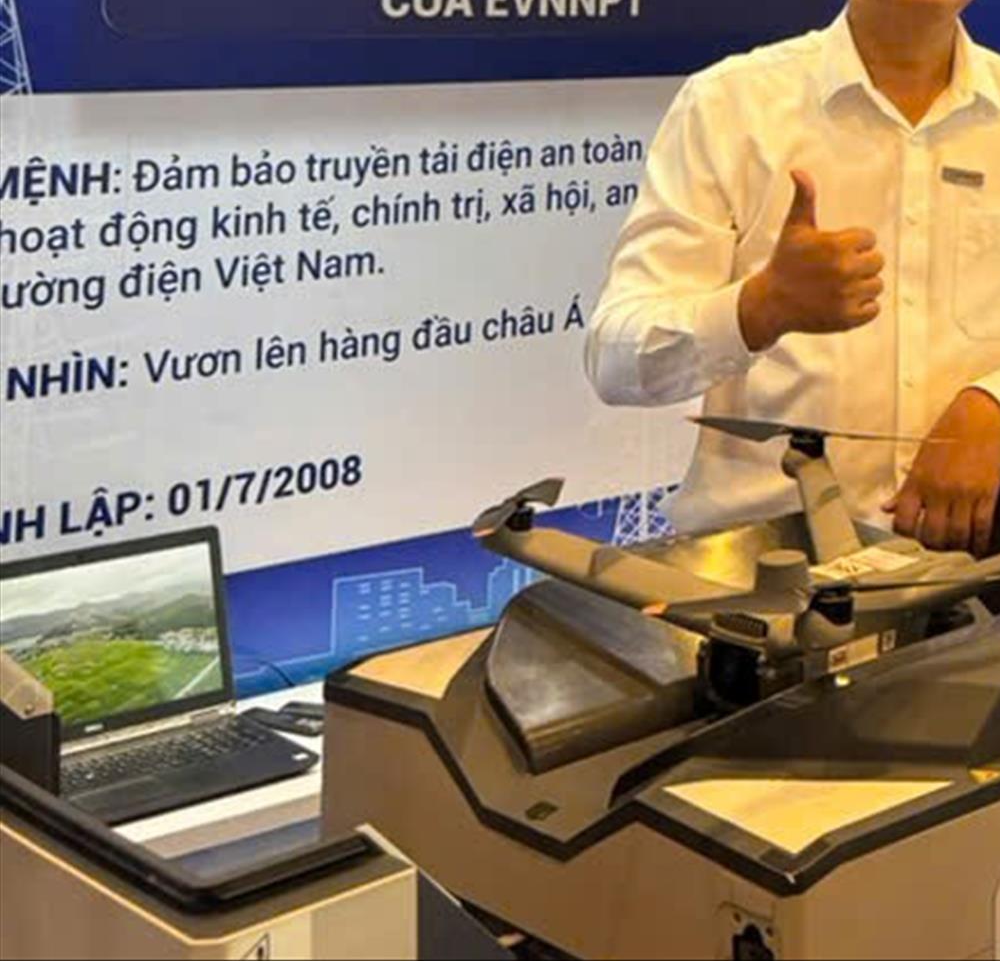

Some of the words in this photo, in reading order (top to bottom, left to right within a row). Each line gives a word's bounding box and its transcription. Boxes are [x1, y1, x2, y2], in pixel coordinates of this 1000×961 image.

[132, 153, 220, 193] Đảm
[231, 149, 296, 187] bảo
[304, 145, 410, 188] truyền
[419, 142, 458, 175] tải
[466, 140, 532, 176] điện
[540, 143, 574, 167] an
[582, 134, 643, 165] toàn
[0, 218, 85, 259] hoạt
[99, 210, 198, 251] động
[211, 201, 286, 239] kinh
[298, 195, 340, 236] tế,
[352, 192, 441, 229] chính
[451, 189, 491, 224] trị,
[501, 184, 535, 216] xã
[546, 181, 596, 217] hội,
[118, 260, 201, 303] điện
[214, 252, 286, 293] Việt
[296, 250, 385, 282] Nam.
[5, 350, 129, 401] NHÌN:
[143, 349, 242, 383] Vươn
[255, 335, 306, 370] lên
[319, 326, 401, 363] hàng
[412, 314, 473, 350] đầu
[482, 306, 555, 341] châu
[564, 294, 585, 330] Á
[60, 487, 154, 537] LẬP:
[168, 454, 362, 516] 01/7/2008
